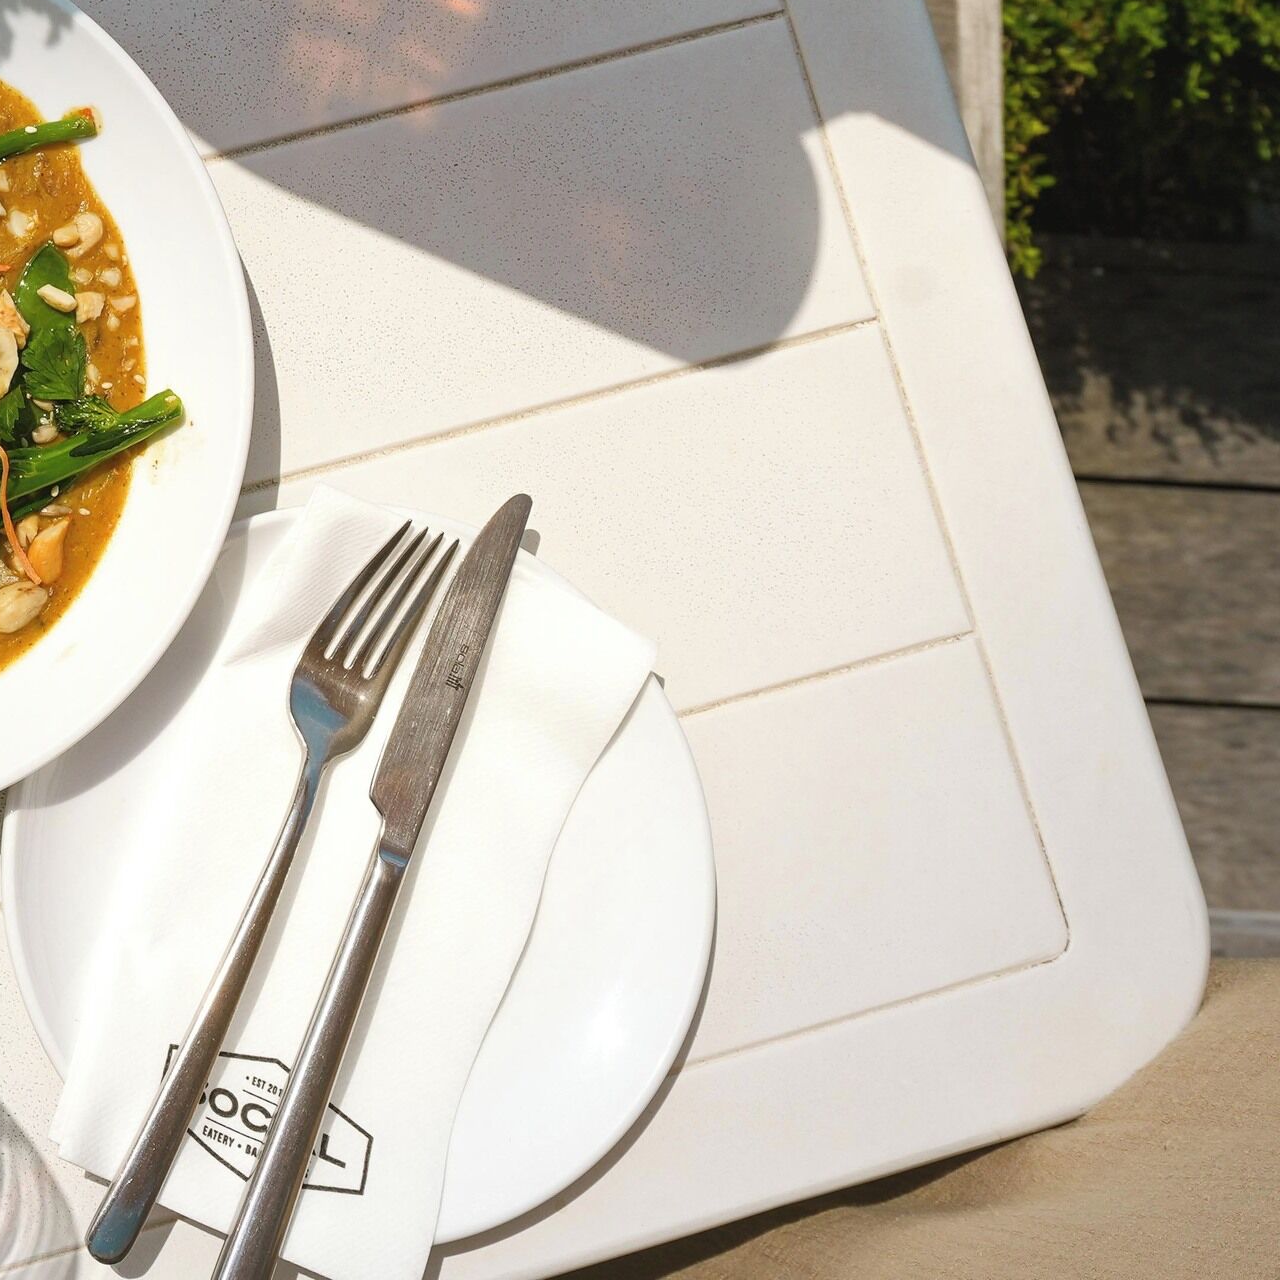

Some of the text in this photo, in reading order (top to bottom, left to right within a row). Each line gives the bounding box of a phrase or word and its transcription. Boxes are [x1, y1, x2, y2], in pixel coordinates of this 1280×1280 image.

[251, 1076, 284, 1097] EST 201
[202, 1125, 259, 1158] EATERY BA
